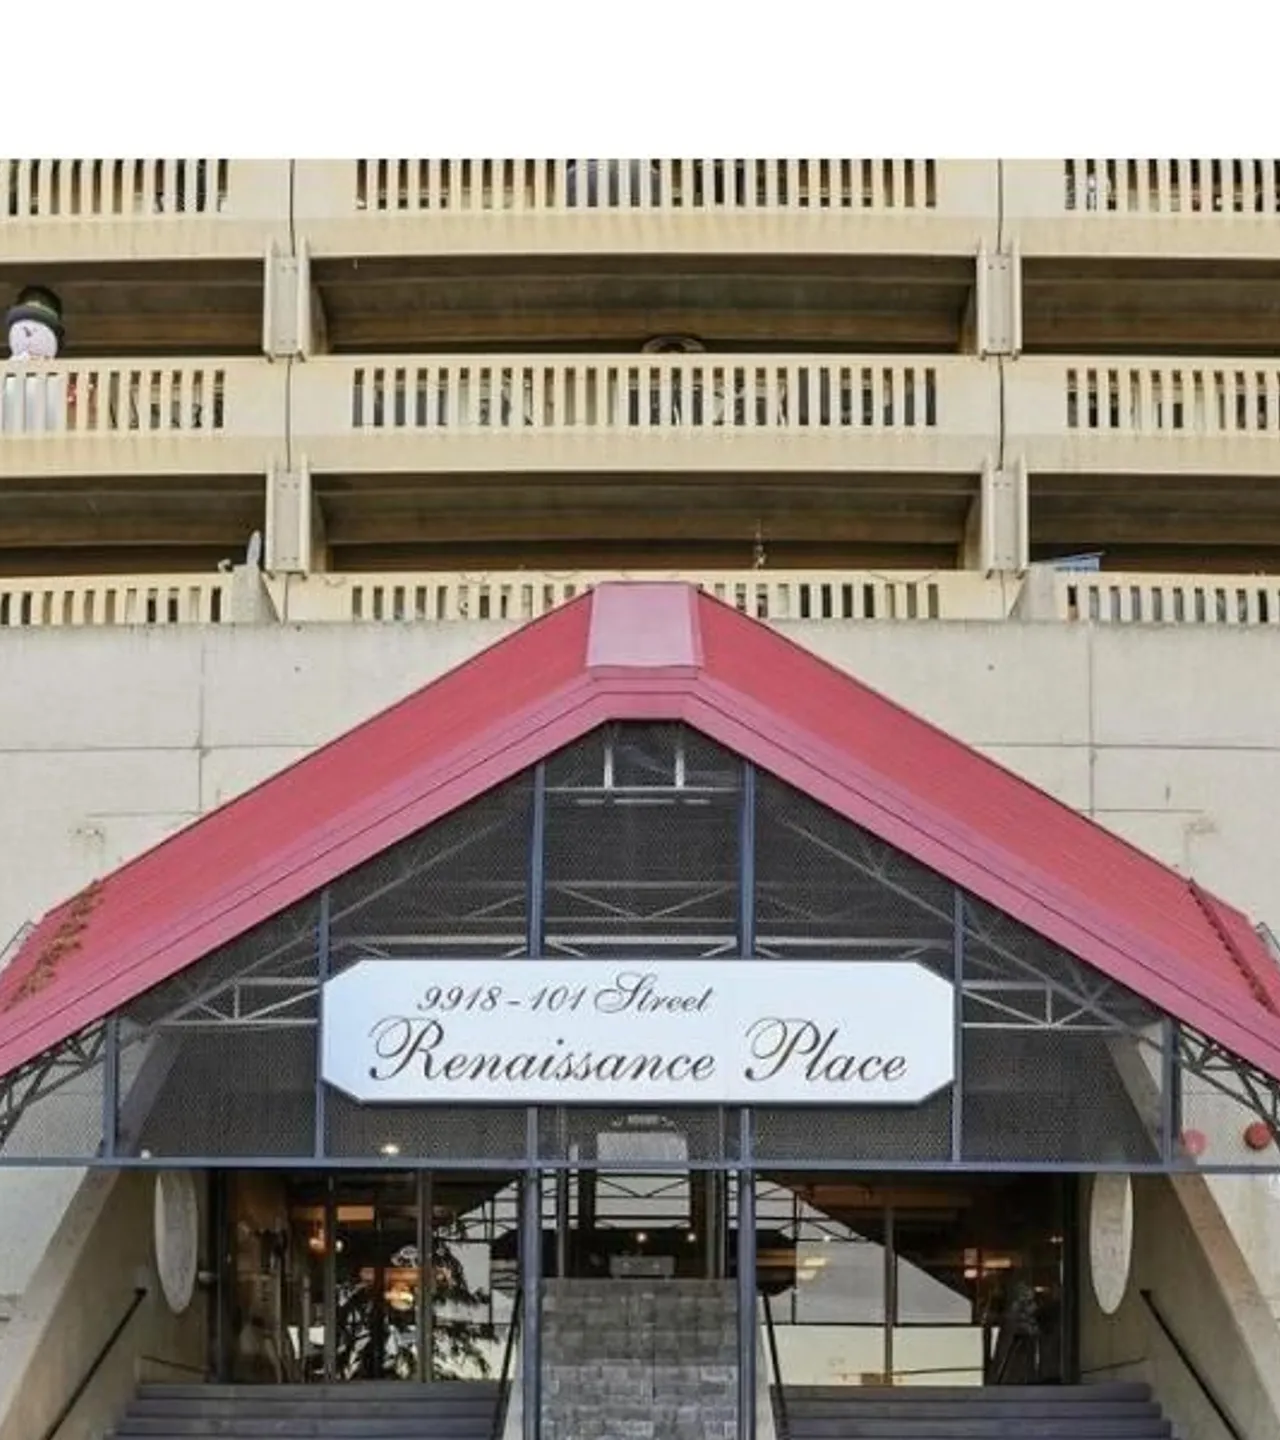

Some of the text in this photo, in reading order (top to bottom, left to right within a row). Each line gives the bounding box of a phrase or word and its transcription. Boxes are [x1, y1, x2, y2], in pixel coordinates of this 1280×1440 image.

[593, 972, 714, 1014] Street
[367, 1016, 908, 1082] Renaissance Place
